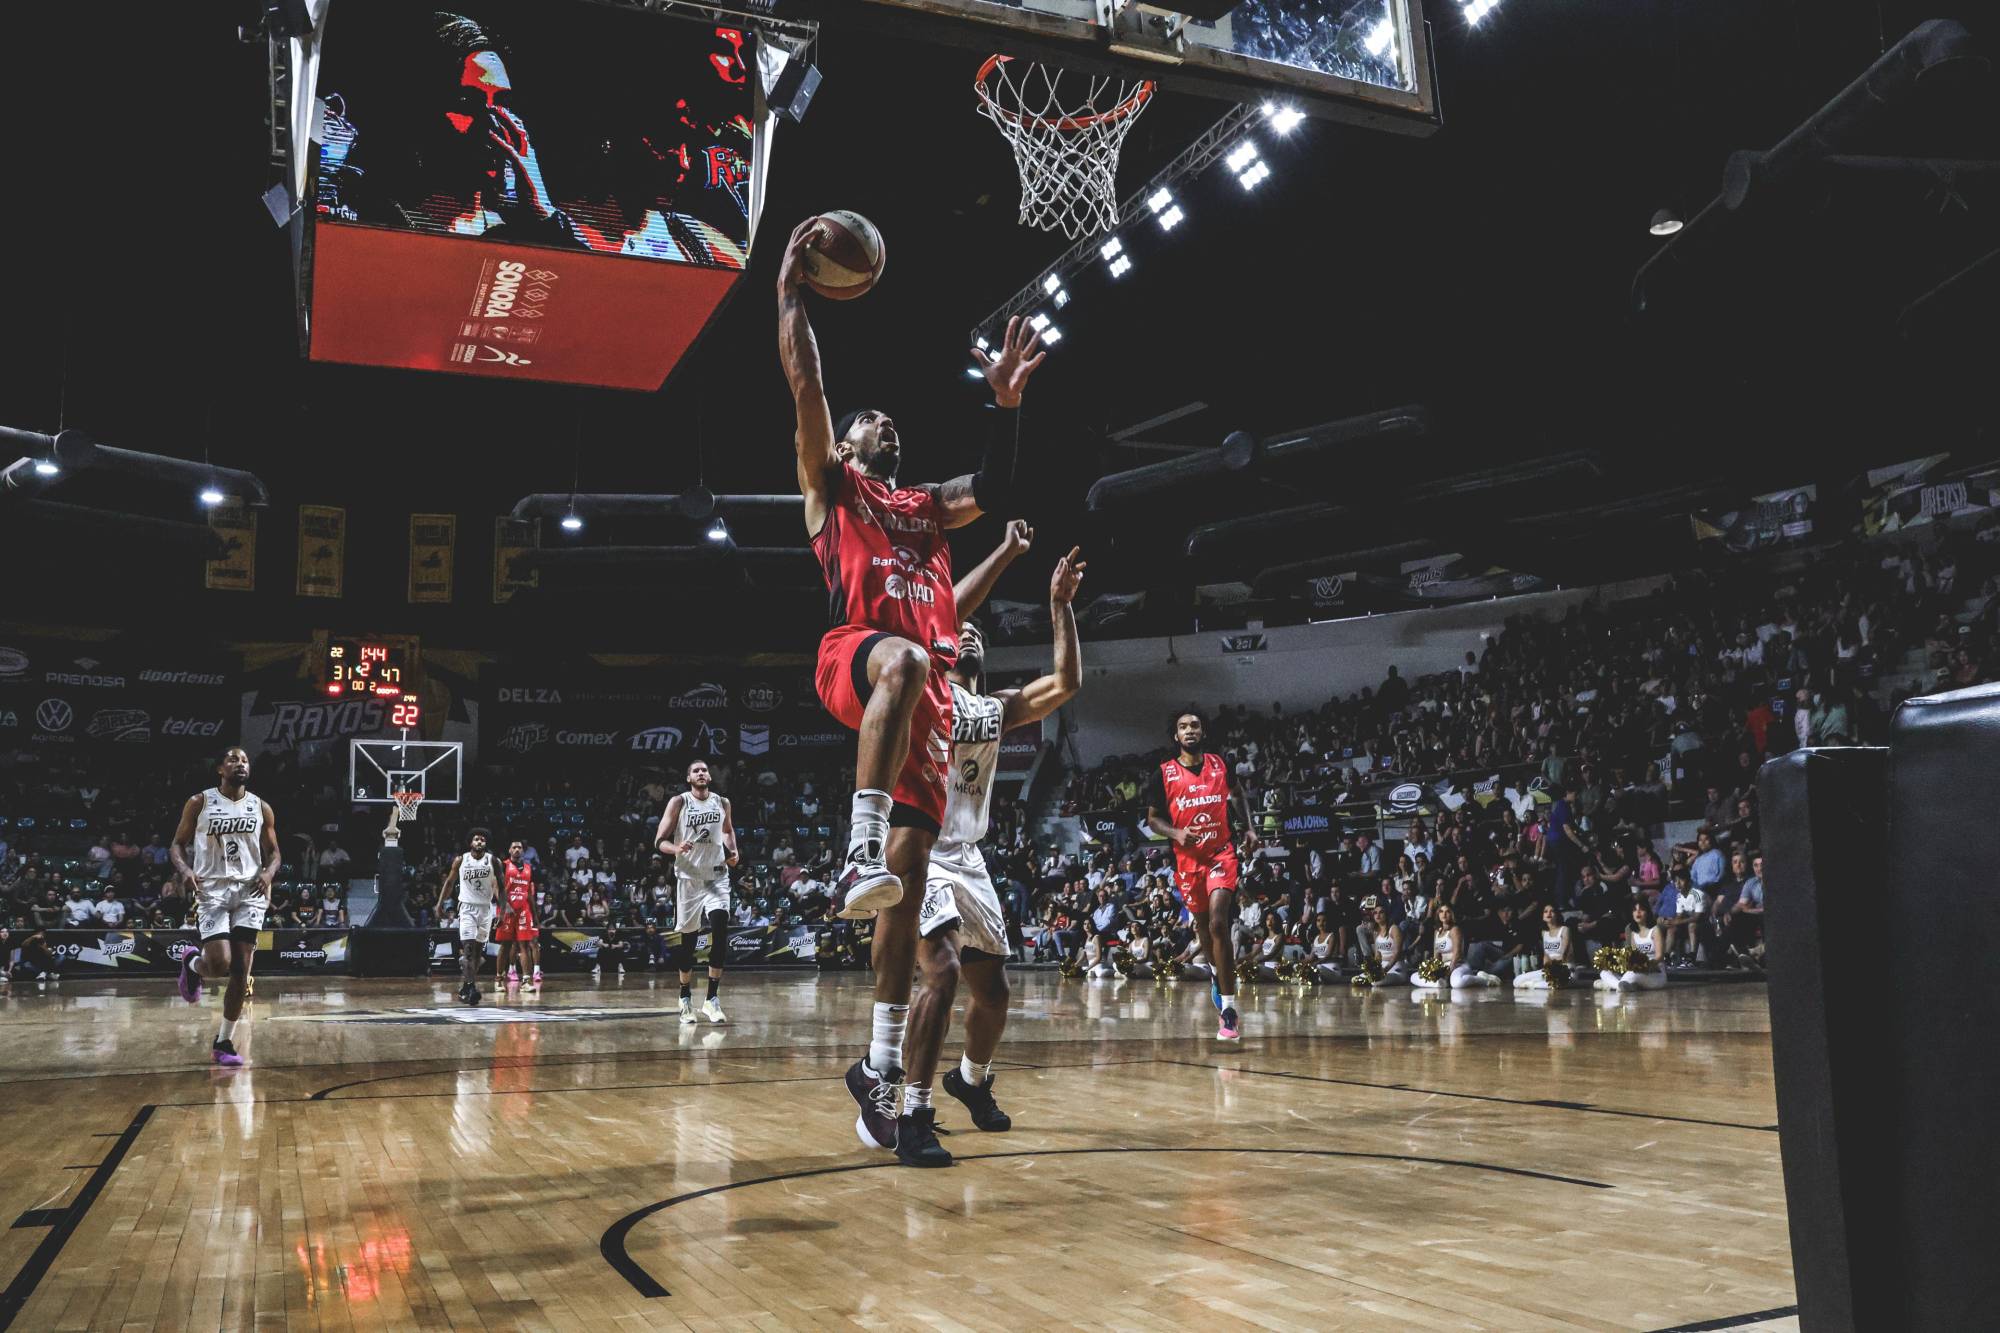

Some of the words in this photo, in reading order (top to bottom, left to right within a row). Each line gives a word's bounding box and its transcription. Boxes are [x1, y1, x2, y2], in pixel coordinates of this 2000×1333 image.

[484, 261, 526, 317] SONORA
[331, 647, 344, 657] 22
[361, 647, 386, 661] 1:44
[46, 671, 125, 688] PRENOSA
[381, 668, 400, 682] 47
[498, 687, 562, 703] DELZA
[669, 691, 728, 708] Electrolit
[392, 704, 418, 725] 22
[161, 716, 224, 736] telcel
[264, 698, 385, 750] RAYOS
[556, 731, 618, 745] Comex
[632, 734, 674, 750] LTH
[999, 744, 1037, 753] ONORA
[954, 782, 982, 795] MEGA
[207, 817, 257, 837] RAYOS
[687, 811, 720, 827] RAYOS
[1284, 816, 1303, 831] PAPA
[1303, 815, 1329, 829] JOHNS
[729, 936, 762, 946] Caliente
[280, 951, 325, 959] PRENOSA
